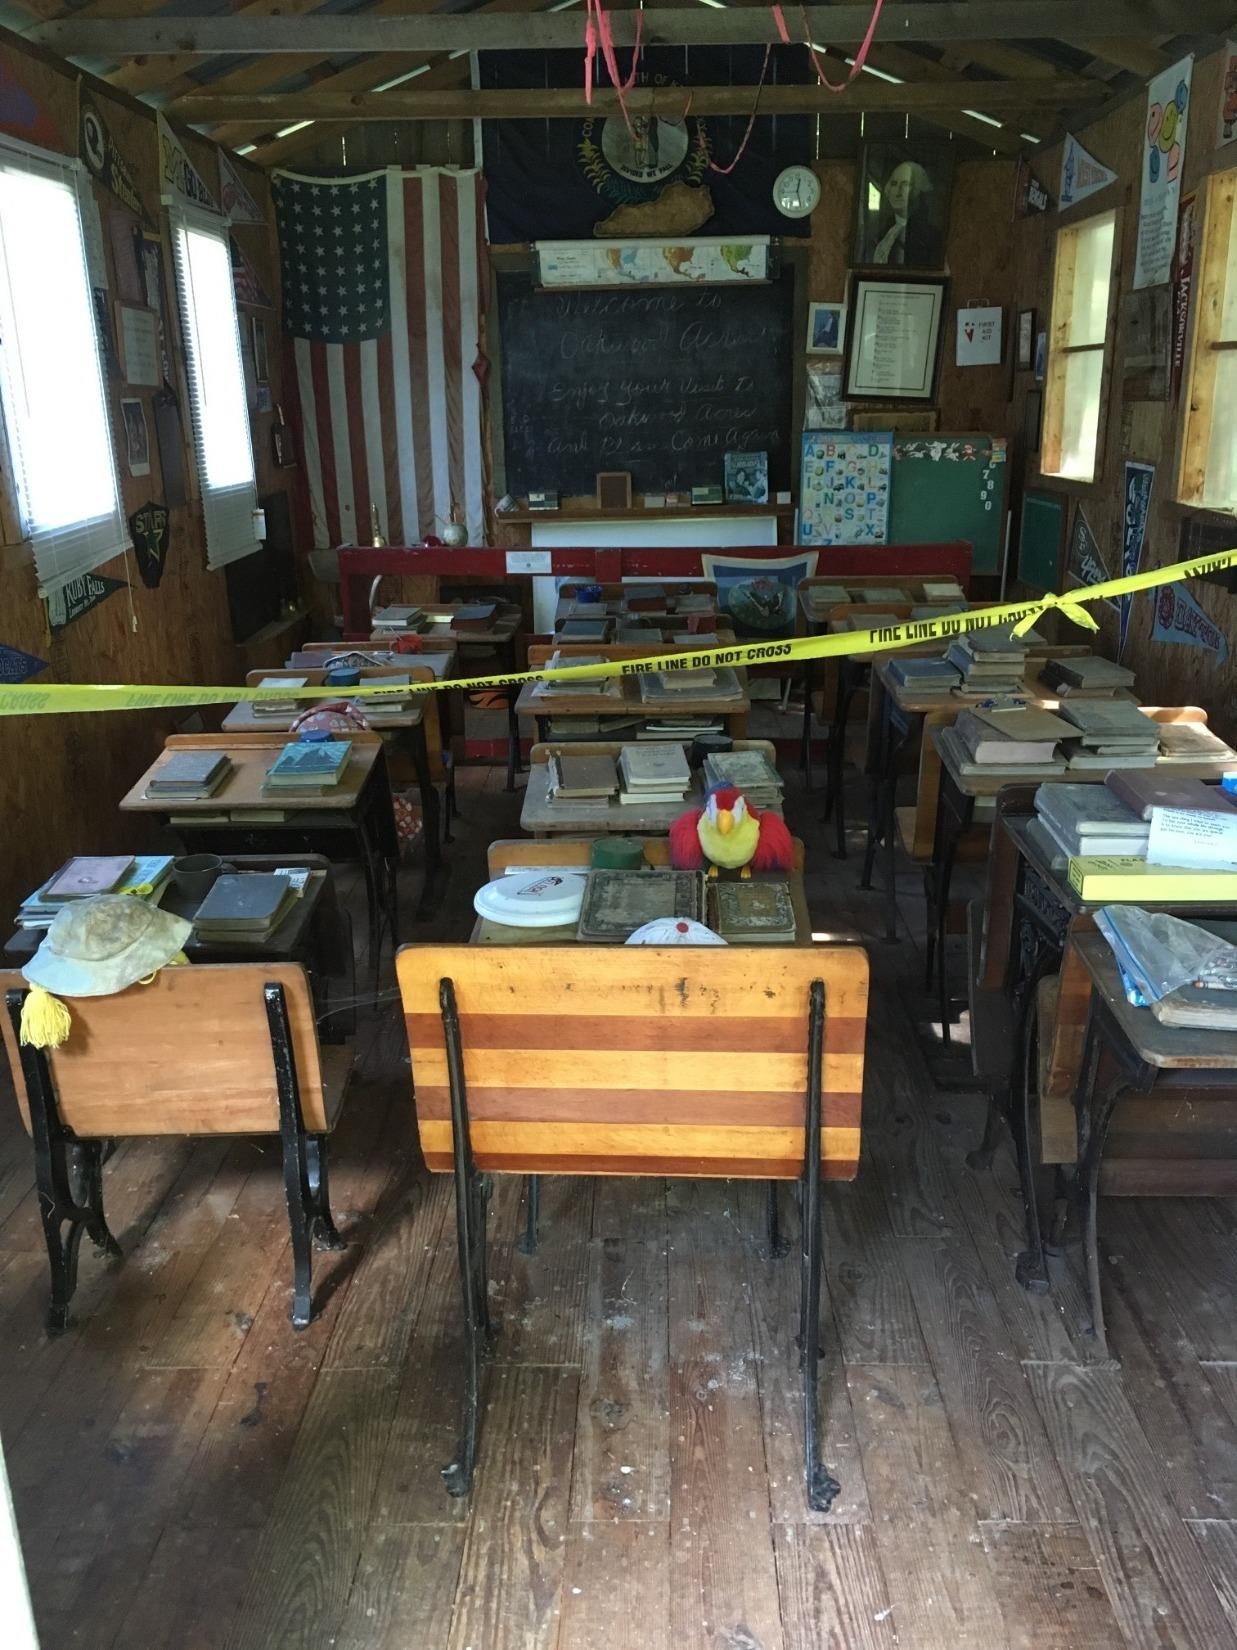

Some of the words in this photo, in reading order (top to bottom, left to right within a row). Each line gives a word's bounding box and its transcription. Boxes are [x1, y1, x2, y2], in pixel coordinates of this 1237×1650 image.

[906, 622, 937, 640] LINE
[622, 662, 653, 675] FIRE
[658, 658, 687, 673] LINE
[692, 655, 711, 667] DO
[715, 650, 742, 666] NOT
[746, 643, 792, 660] CROSS
